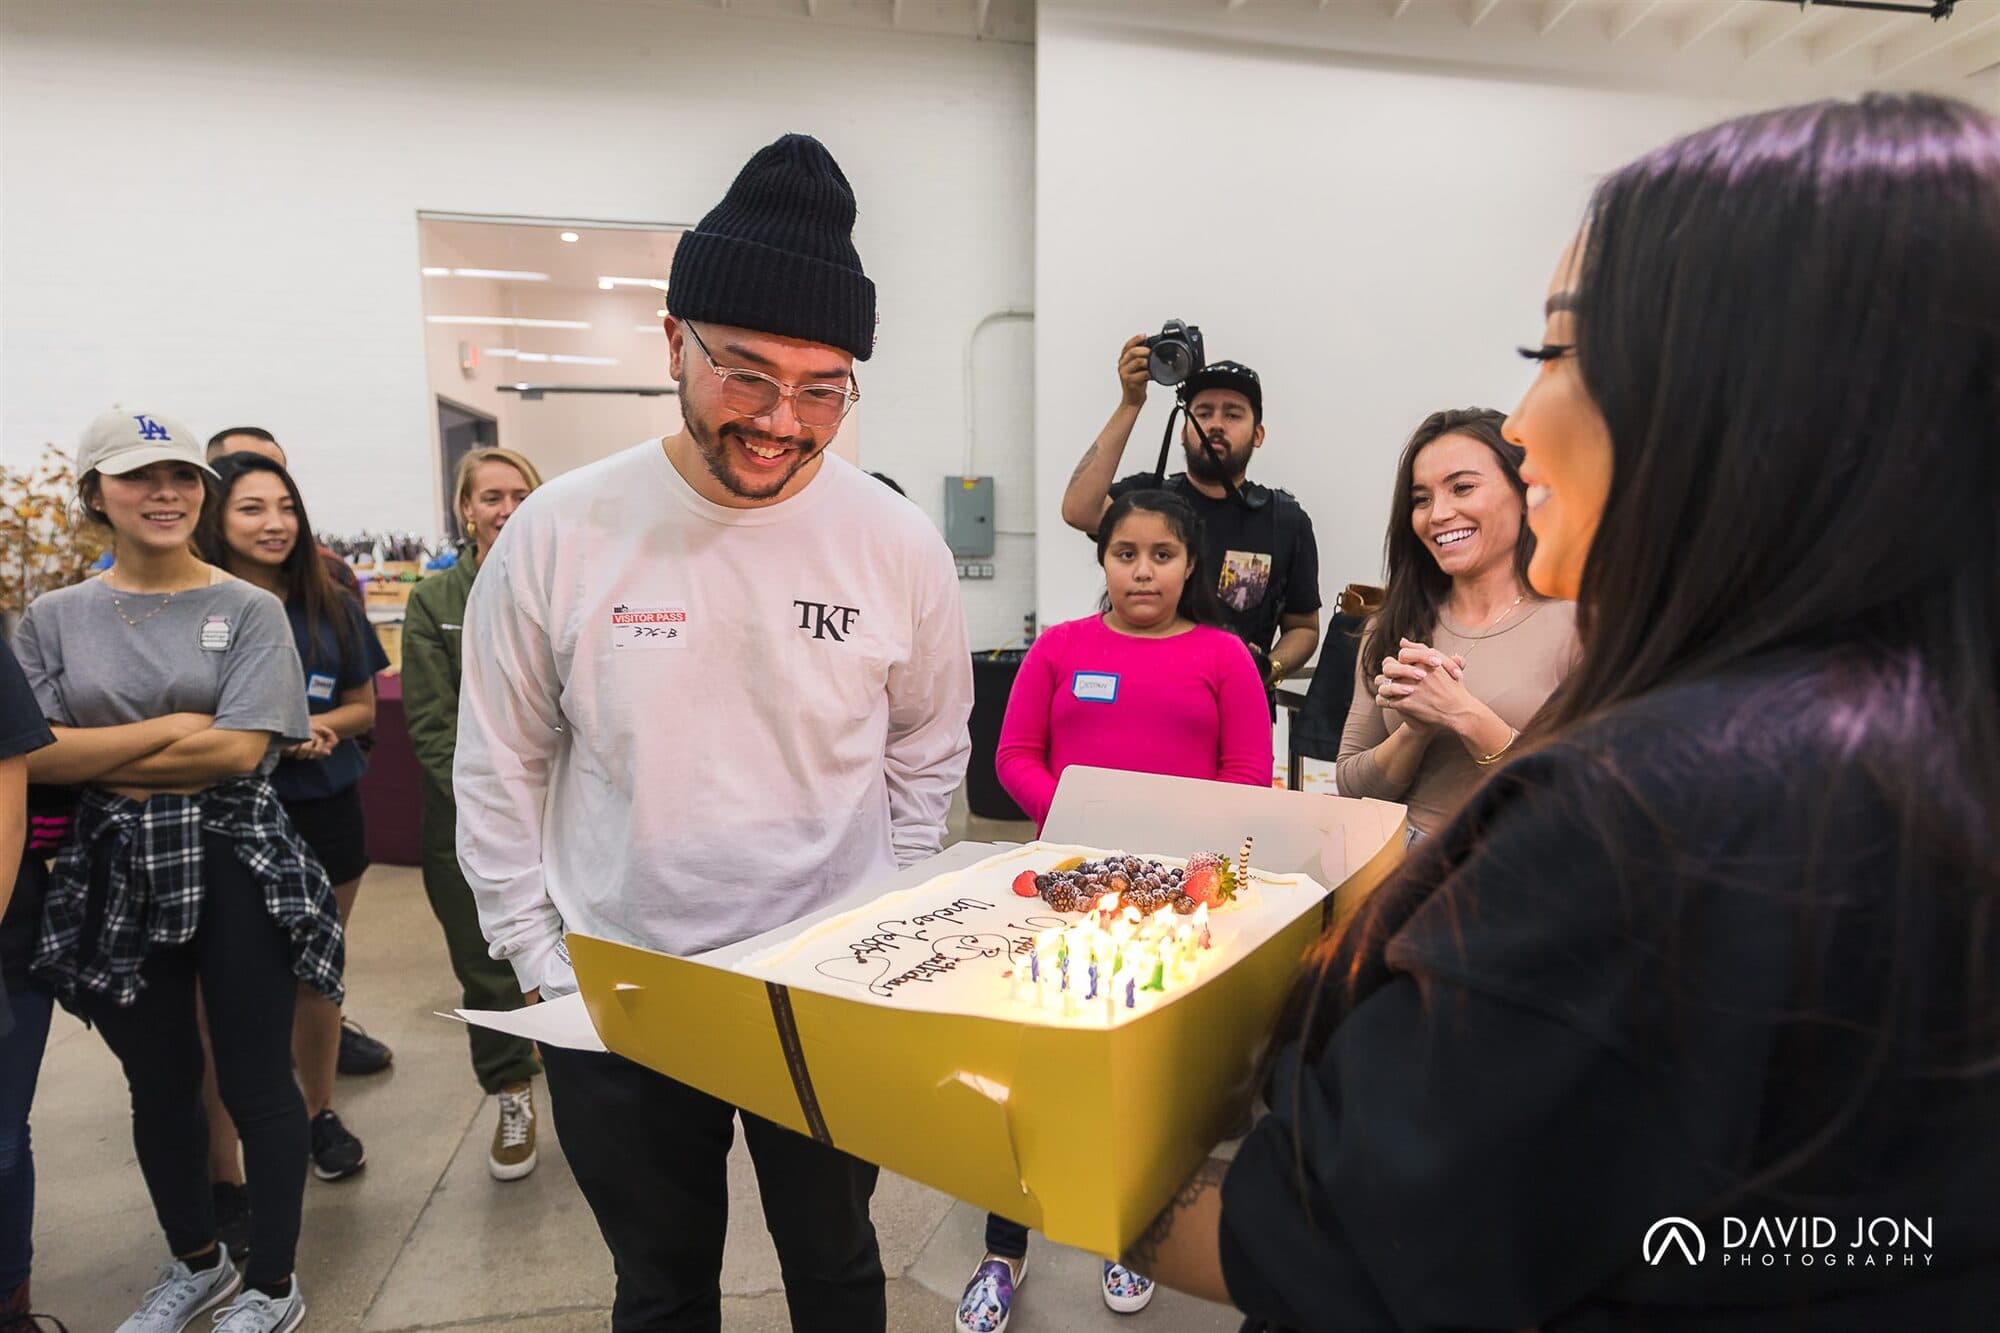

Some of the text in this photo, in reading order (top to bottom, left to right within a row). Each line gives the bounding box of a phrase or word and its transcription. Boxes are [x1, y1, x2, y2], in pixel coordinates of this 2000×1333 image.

[133, 415, 171, 441] LA
[615, 613, 683, 623] VISITOR PASS
[793, 600, 860, 642] TKF
